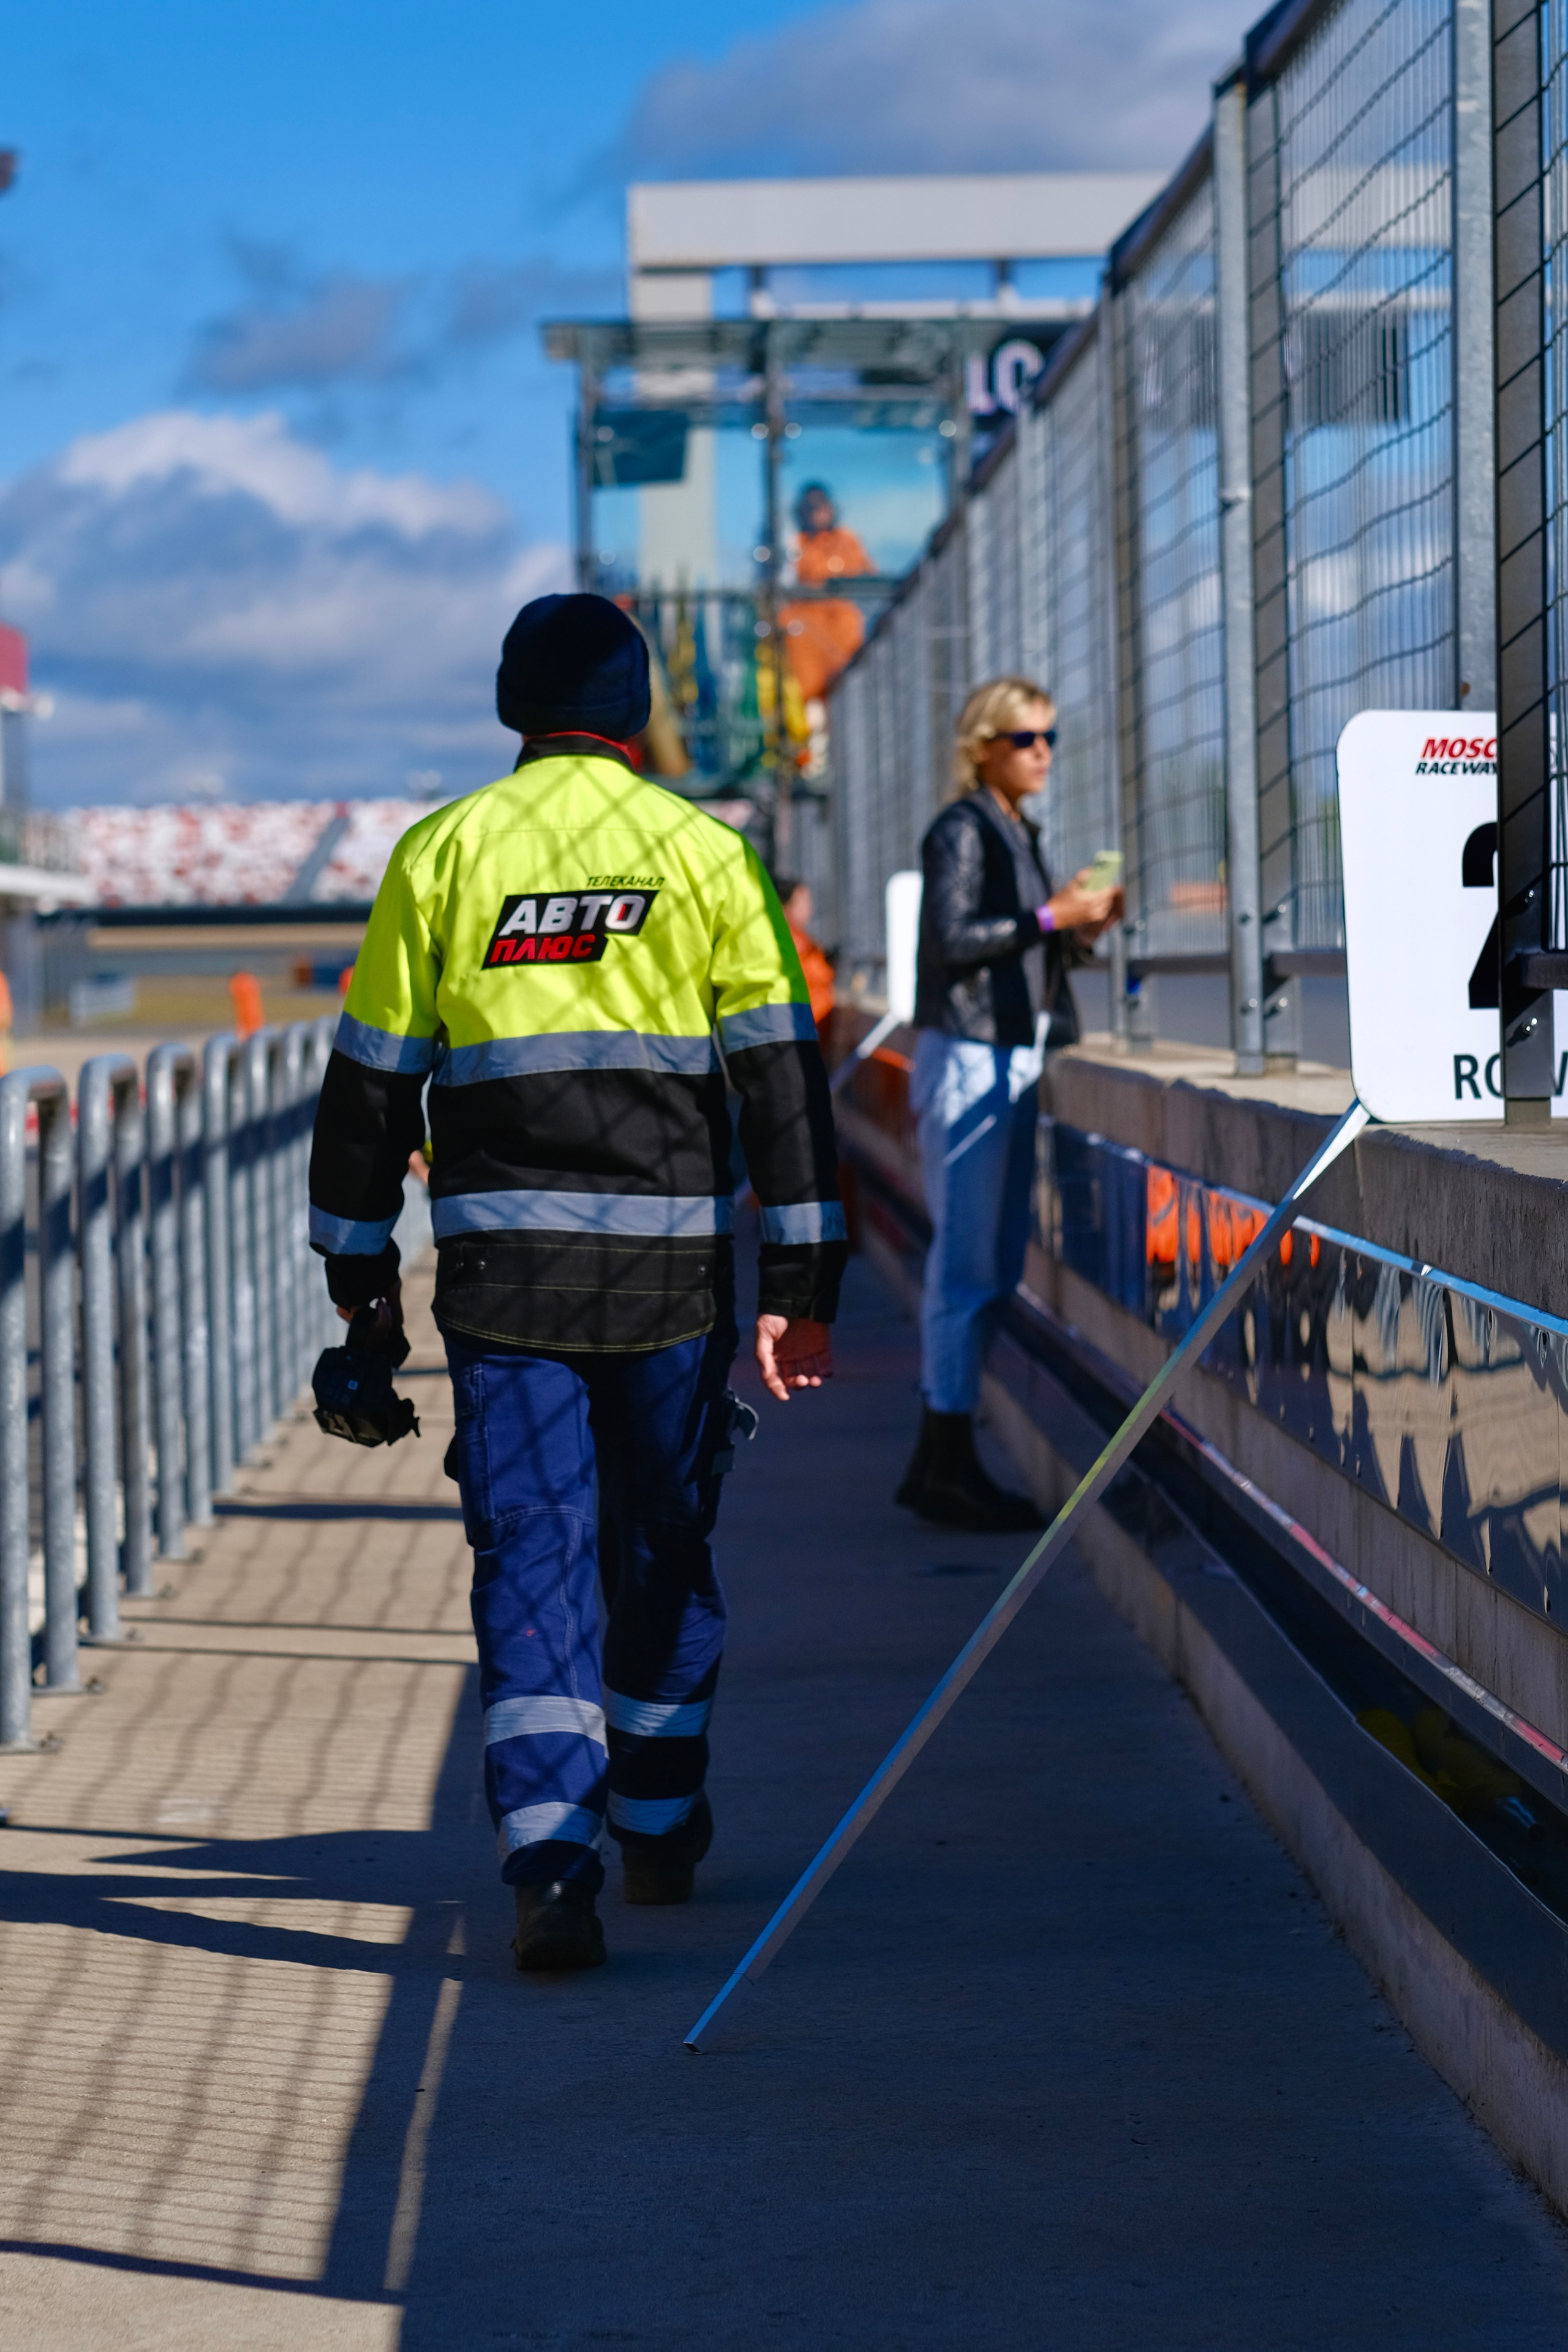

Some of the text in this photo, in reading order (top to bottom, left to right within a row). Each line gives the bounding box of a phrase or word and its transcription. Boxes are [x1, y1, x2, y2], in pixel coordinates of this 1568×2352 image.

[1422, 738, 1497, 758] MOSC
[587, 875, 665, 887] ТЕЛЕКАНАЛ
[498, 894, 646, 936] АВТО
[490, 934, 595, 963] ПЛЮС
